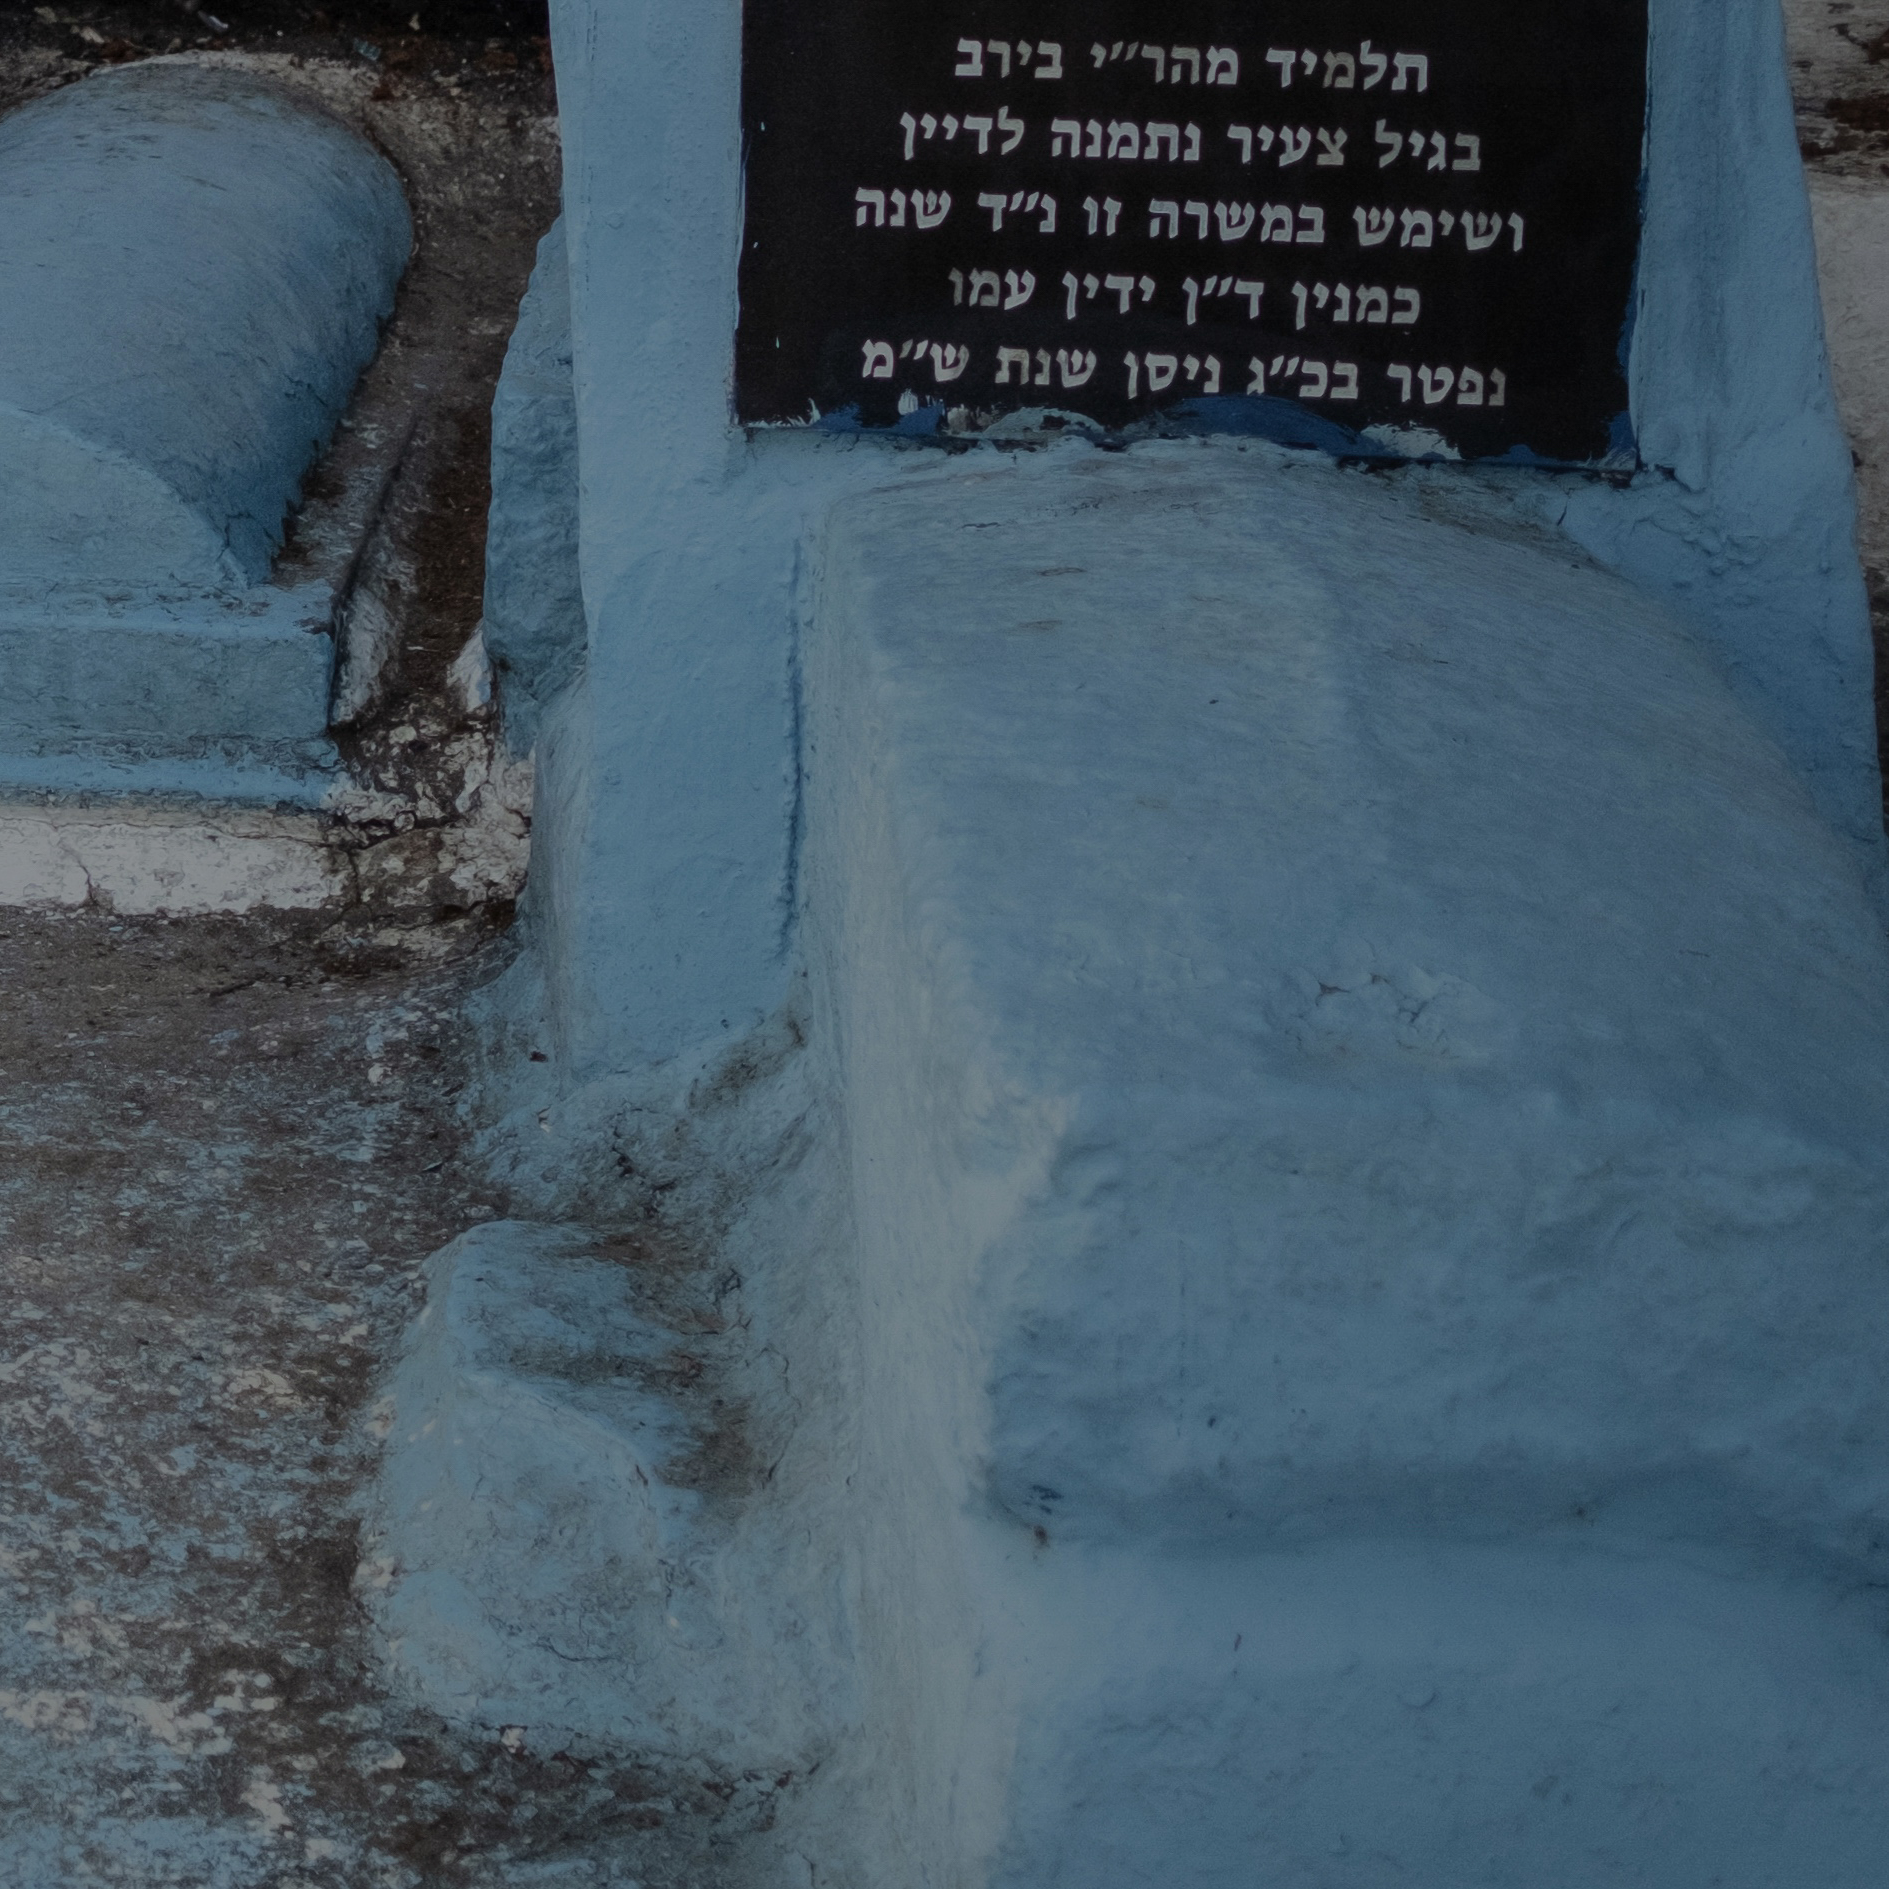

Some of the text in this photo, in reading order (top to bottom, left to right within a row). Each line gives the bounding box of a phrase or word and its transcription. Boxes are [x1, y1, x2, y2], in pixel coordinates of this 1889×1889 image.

[954, 37, 1064, 80] בירב
[1264, 39, 1429, 93] תלמיד
[899, 105, 1481, 171] בגיל צעיר נתמנה לדיין
[854, 186, 953, 230] שנה
[1082, 195, 1123, 237] זו
[1148, 198, 1326, 244] במשרה
[1352, 205, 1525, 253] ושימש
[948, 268, 1037, 311] עמו
[1061, 270, 1157, 321] ידין
[1291, 280, 1421, 331] כמנין
[994, 345, 1098, 388] שנת
[1123, 350, 1222, 399] ניסן
[1386, 362, 1506, 407] נפטר
